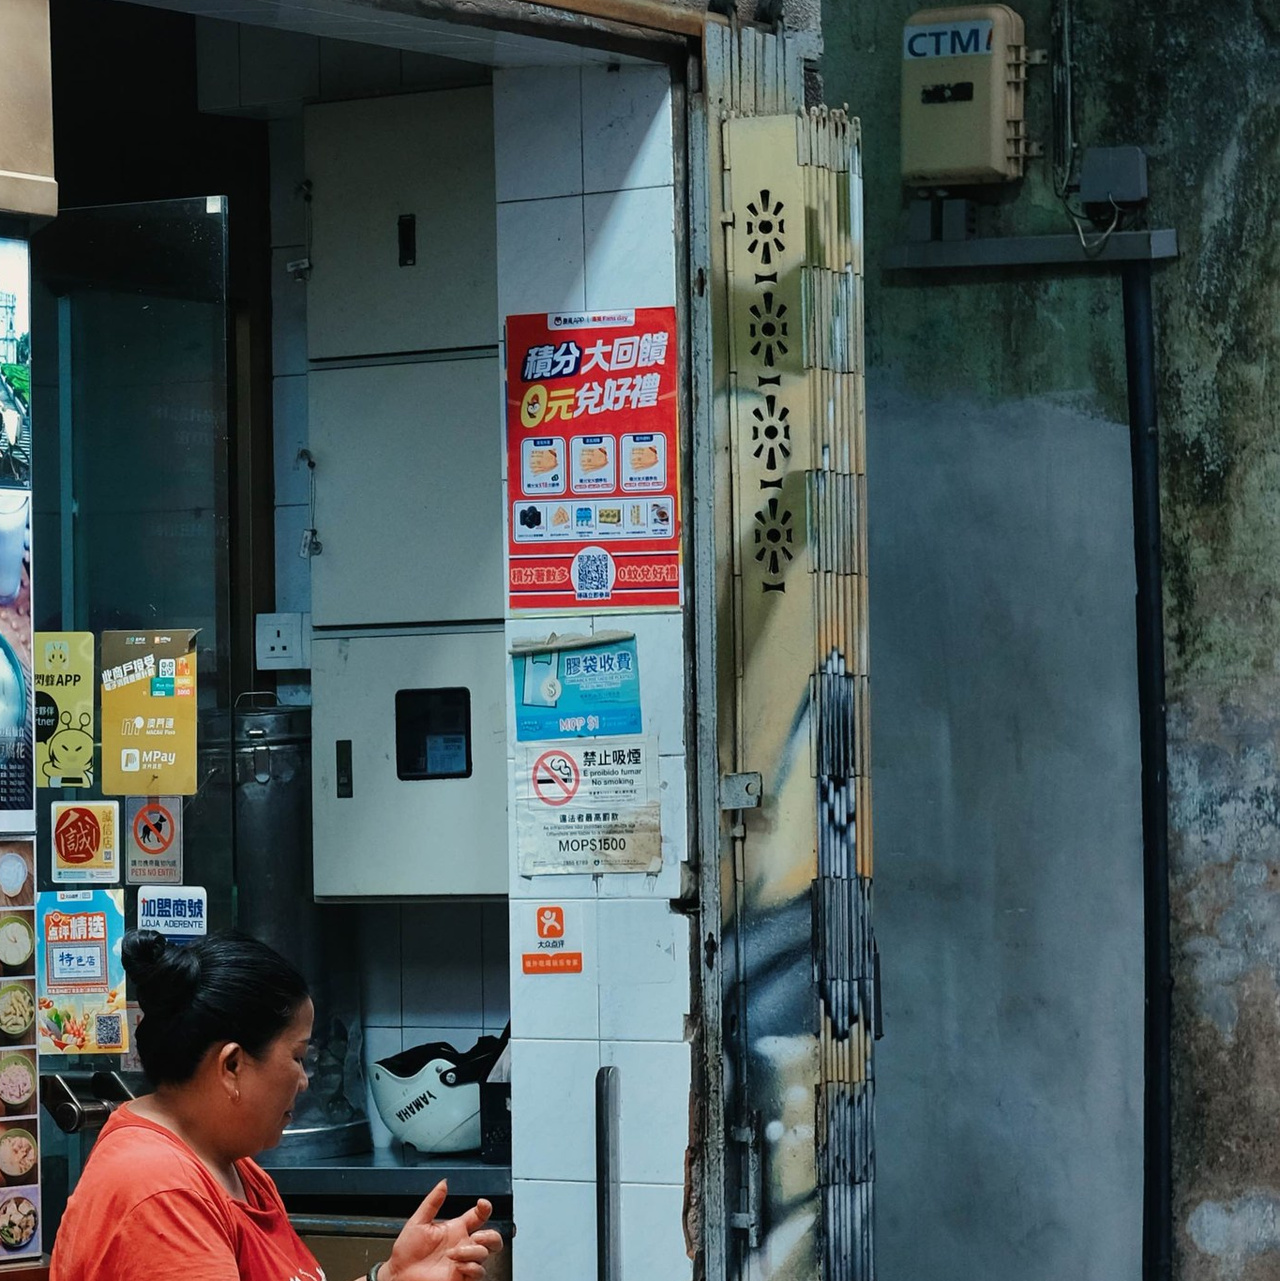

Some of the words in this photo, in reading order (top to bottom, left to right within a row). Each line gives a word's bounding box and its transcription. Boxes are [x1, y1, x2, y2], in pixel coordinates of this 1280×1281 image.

[907, 29, 980, 58] CTM
[566, 652, 632, 676] 膠袋收費
[142, 751, 176, 765] MPay
[583, 749, 641, 767] 禁止吸煙
[590, 769, 619, 780] proibido
[620, 768, 642, 776] fumar
[603, 778, 634, 787] smoking
[131, 868, 146, 877] PETS
[147, 868, 157, 876] NO
[141, 897, 204, 918] 加盟商號
[141, 919, 161, 929] LOJA
[163, 919, 204, 929] ADERENTE
[59, 952, 96, 967] 特色店
[395, 1089, 437, 1123] YAMAHA
